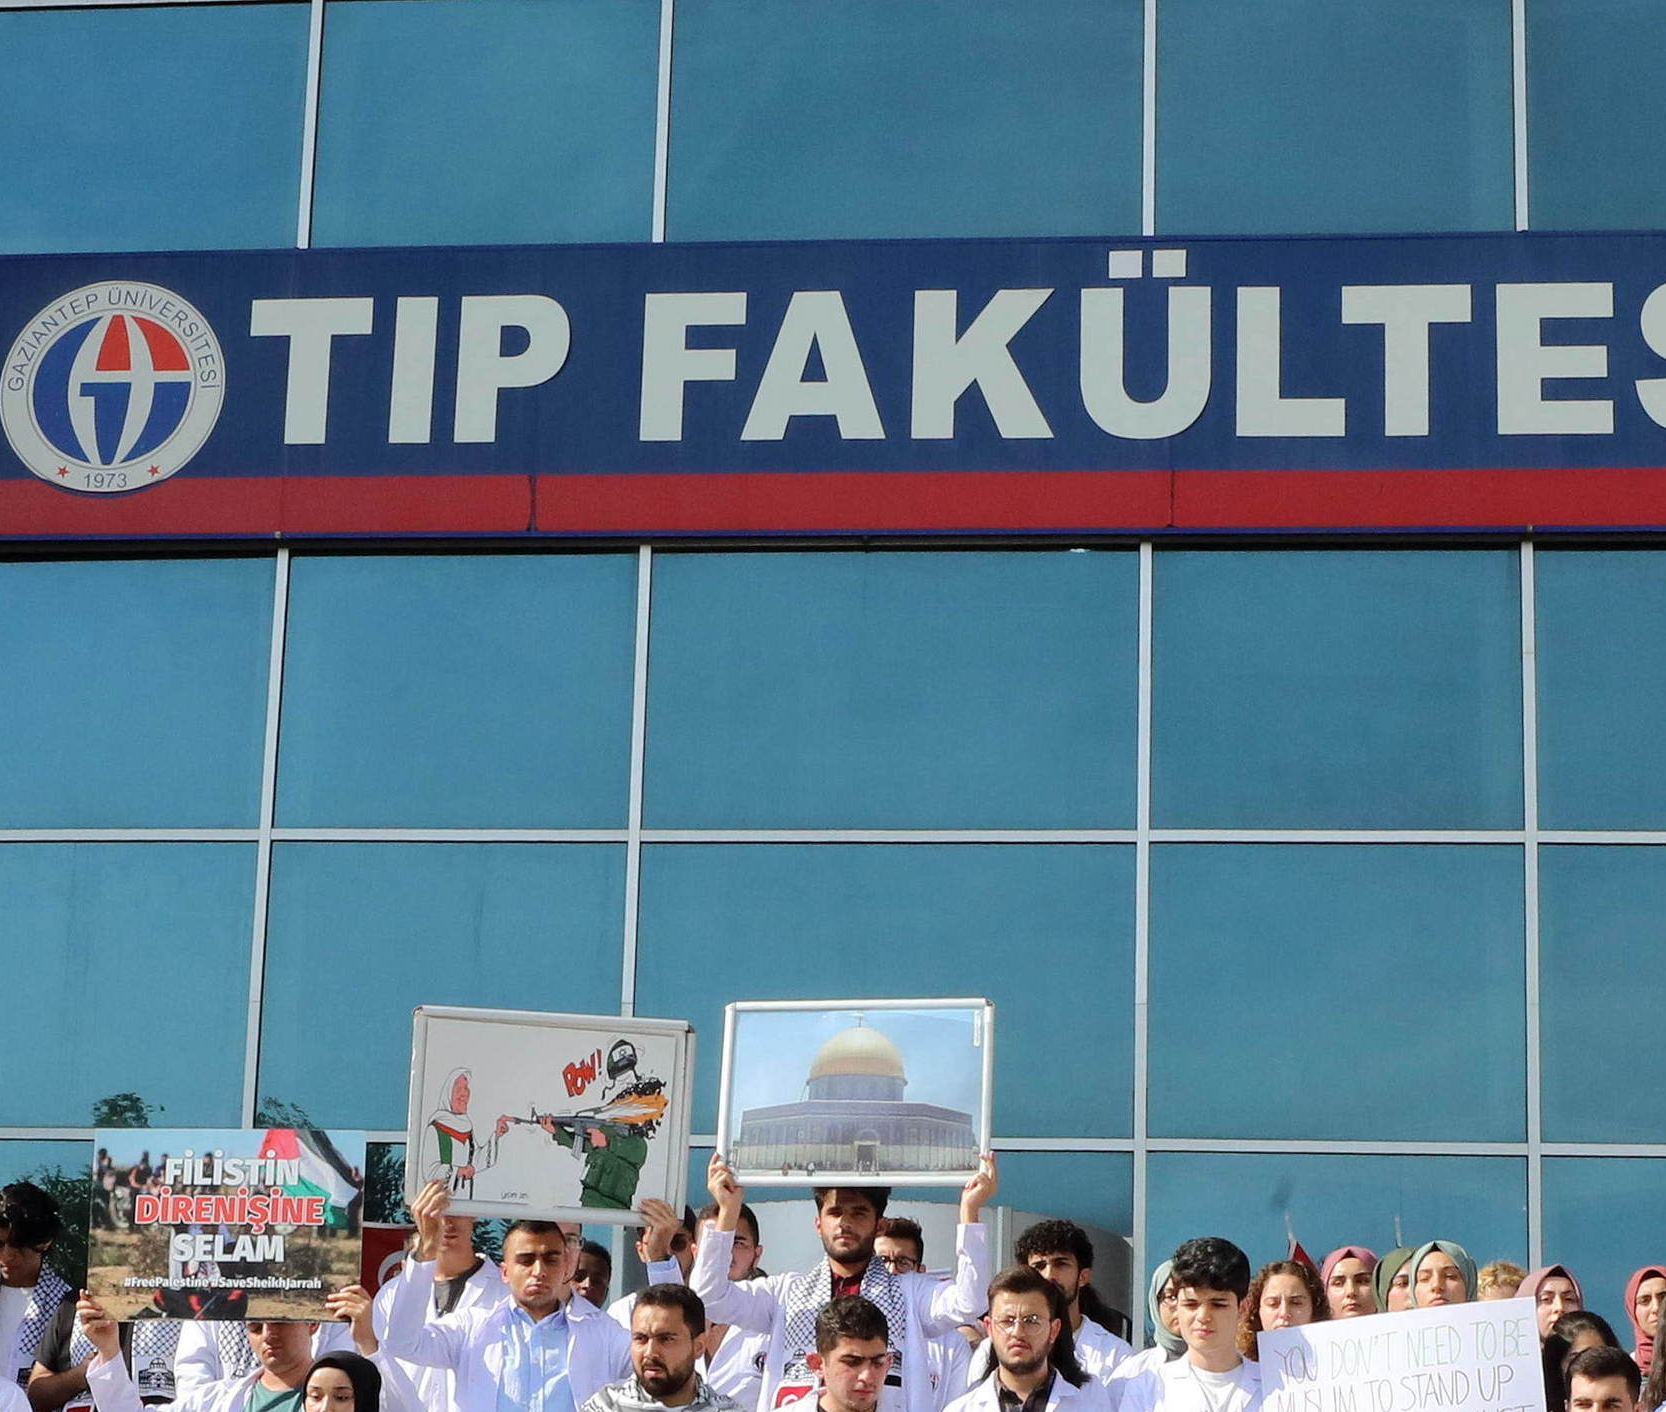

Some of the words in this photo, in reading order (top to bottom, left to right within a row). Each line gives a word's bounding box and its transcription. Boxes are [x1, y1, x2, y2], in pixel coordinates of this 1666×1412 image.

[8, 293, 98, 392] GAZİANTEP
[108, 287, 220, 390] ÜNİVERSİTESİ
[250, 294, 571, 445] TIP
[84, 473, 128, 488] 1973
[561, 1048, 602, 1097] POW!
[165, 1150, 301, 1186] FİLİSTİN
[135, 1187, 325, 1233] DİRENİŞİNE
[171, 1233, 285, 1262] SELAM
[124, 1276, 209, 1289] #FreePalestine
[211, 1276, 322, 1290] #SaveSheikhJarrah
[1274, 1346, 1318, 1385] YOU
[1331, 1332, 1397, 1380] DON'T
[1406, 1325, 1461, 1369] NEED
[1469, 1320, 1496, 1360] TO
[1503, 1318, 1531, 1357] BE
[1400, 1370, 1470, 1412] STAND
[1478, 1364, 1514, 1401] UP
